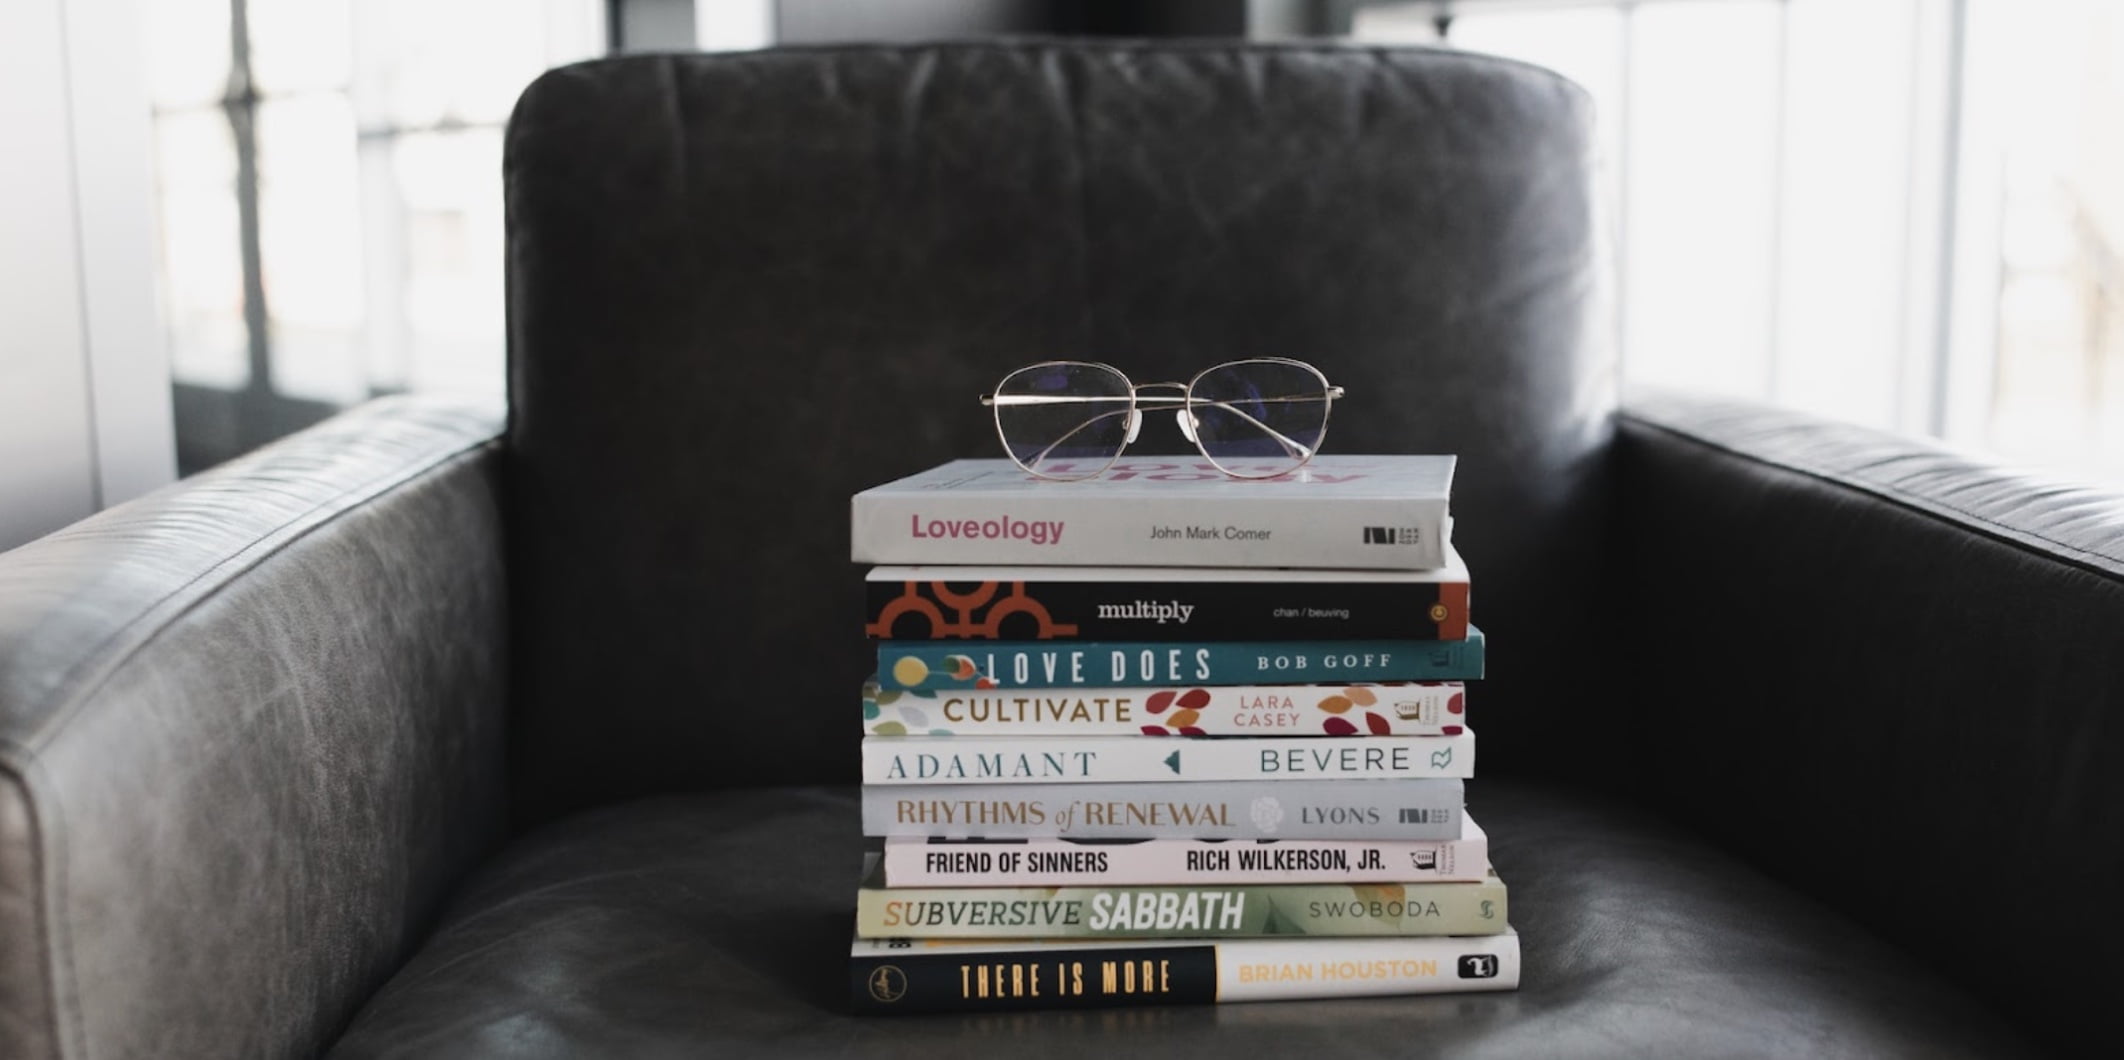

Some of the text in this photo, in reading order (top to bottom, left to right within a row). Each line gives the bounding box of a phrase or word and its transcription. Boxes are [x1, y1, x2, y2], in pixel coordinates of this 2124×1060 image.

[912, 515, 1064, 545] Loveology
[1150, 526, 1271, 540] John Mark Comer
[1098, 601, 1194, 624] multiply
[1273, 608, 1299, 617] chan
[1308, 608, 1349, 619] beuving
[988, 649, 1209, 684] LOVE DOES
[1258, 654, 1390, 669] BOB GOFF
[944, 698, 1131, 722] CULTIVATE
[1241, 696, 1293, 709] LARA
[1234, 713, 1300, 726] CASEY
[887, 752, 1096, 779] ADAMANT
[1261, 748, 1409, 772] BEVERE
[898, 801, 1236, 831] RHYTHMS of RENEWAL
[1302, 807, 1380, 824] LYONS
[927, 852, 1108, 873] FRIEND OF SINNERS
[1187, 849, 1385, 872] RICH WILKERSON, JR.
[884, 892, 1244, 930] SUBVERSIVE SABBATH
[1310, 901, 1440, 917] SWOBODA
[961, 960, 1168, 998] THERE IS MORE
[1240, 960, 1437, 982] BRIAN HOUSTON
